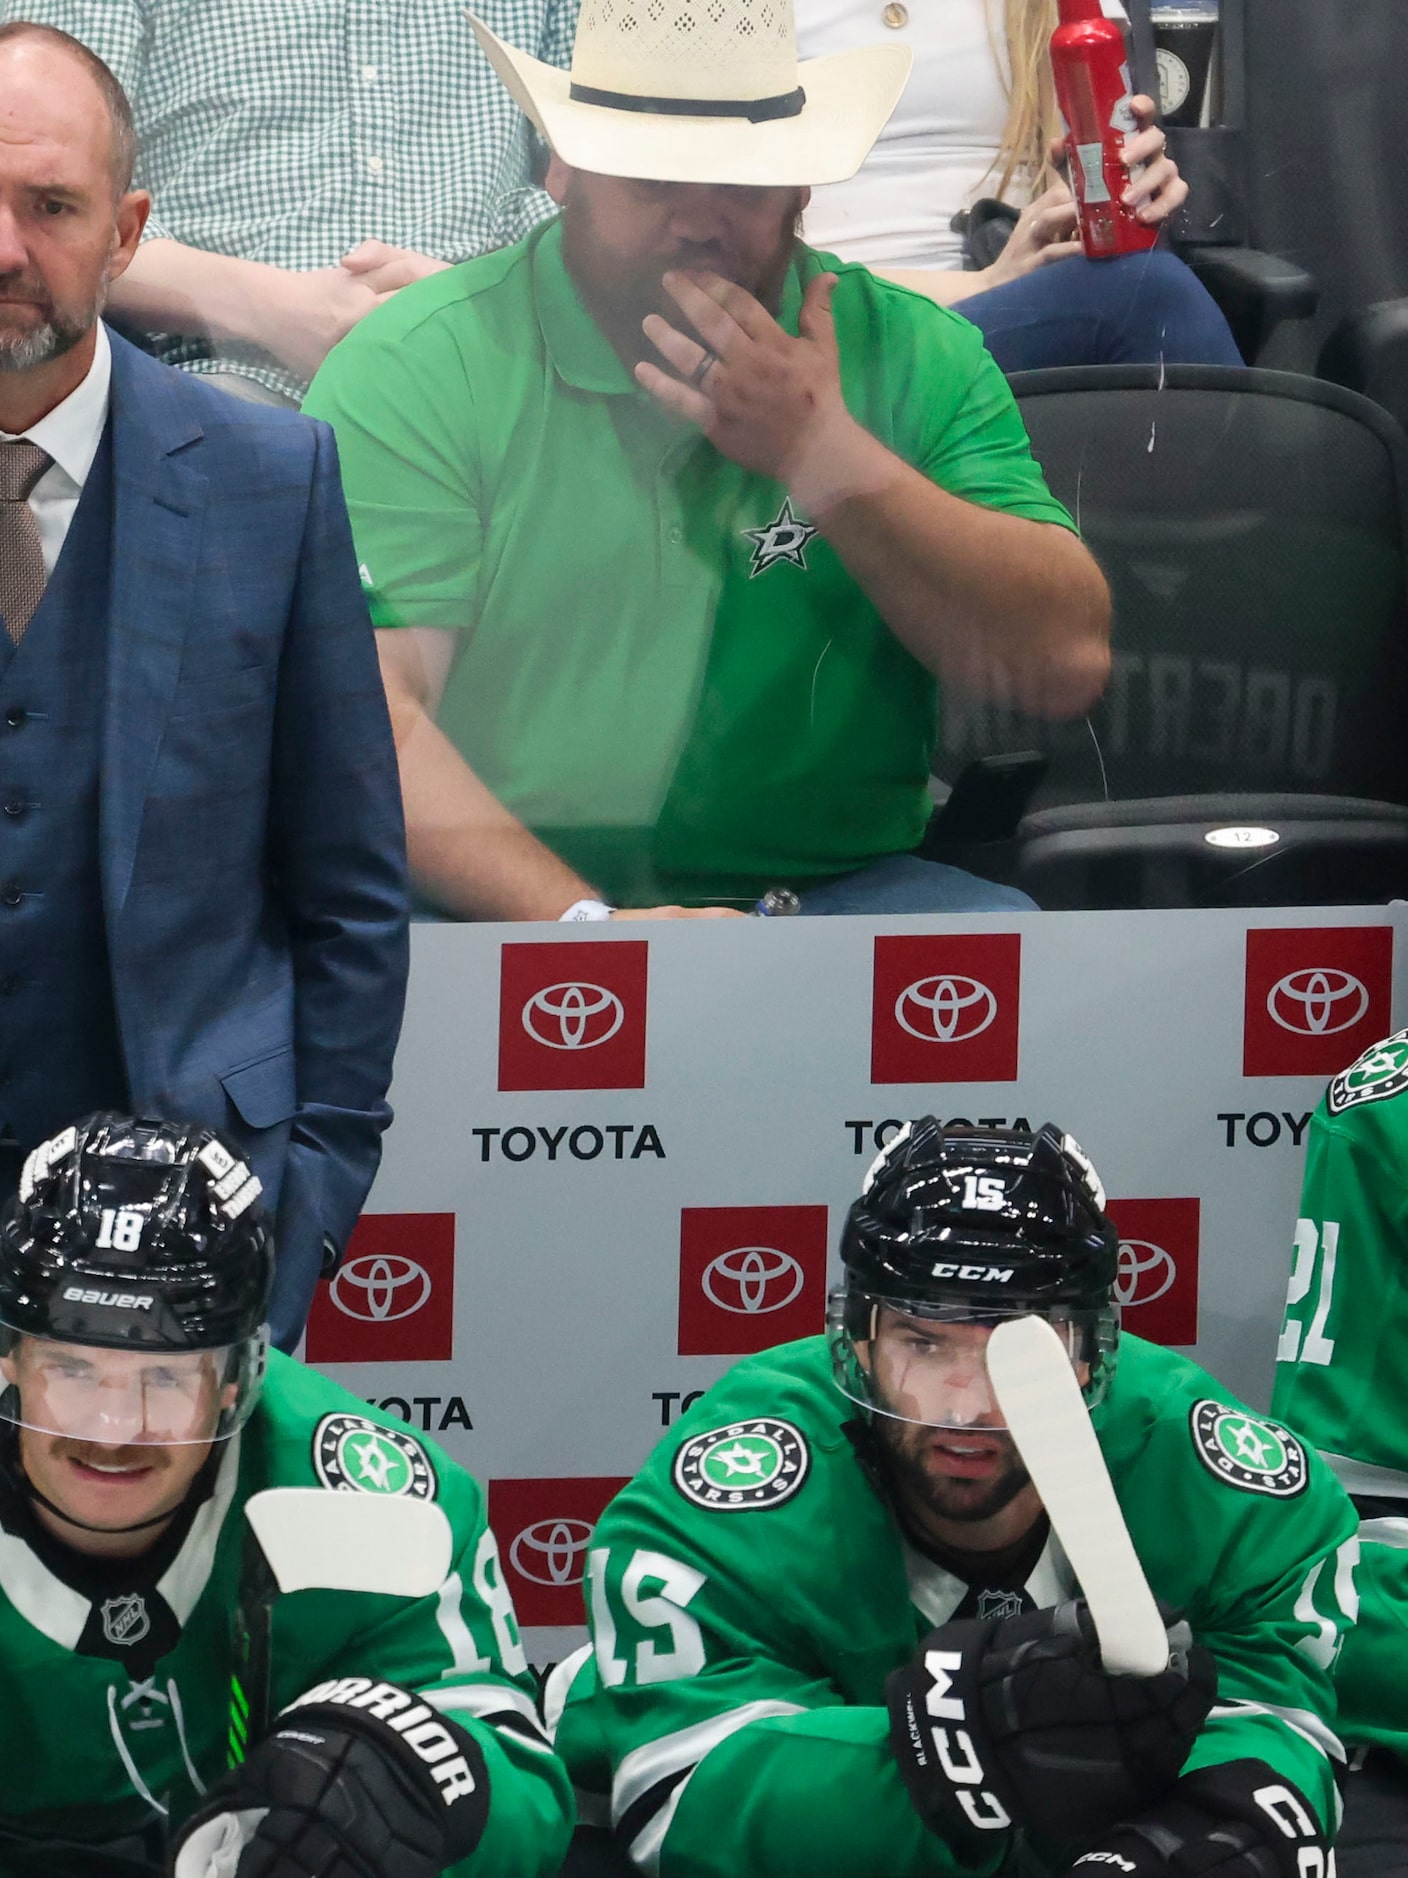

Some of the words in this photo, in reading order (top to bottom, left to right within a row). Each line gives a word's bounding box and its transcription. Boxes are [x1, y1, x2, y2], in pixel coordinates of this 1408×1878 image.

[1235, 832, 1252, 842] 12
[472, 1125, 666, 1161] TOYOTA
[1217, 1111, 1313, 1147] TOY
[962, 1175, 1006, 1212] 15
[95, 1208, 144, 1253] 18
[931, 1262, 1015, 1283] CCM
[1275, 1218, 1341, 1367] 21
[366, 1396, 474, 1431] OTA
[114, 1607, 139, 1638] NHL
[439, 1528, 529, 1680] 18
[587, 1548, 707, 1689] 15
[924, 1650, 1012, 1830] CCM
[1252, 1785, 1326, 1878] CC
